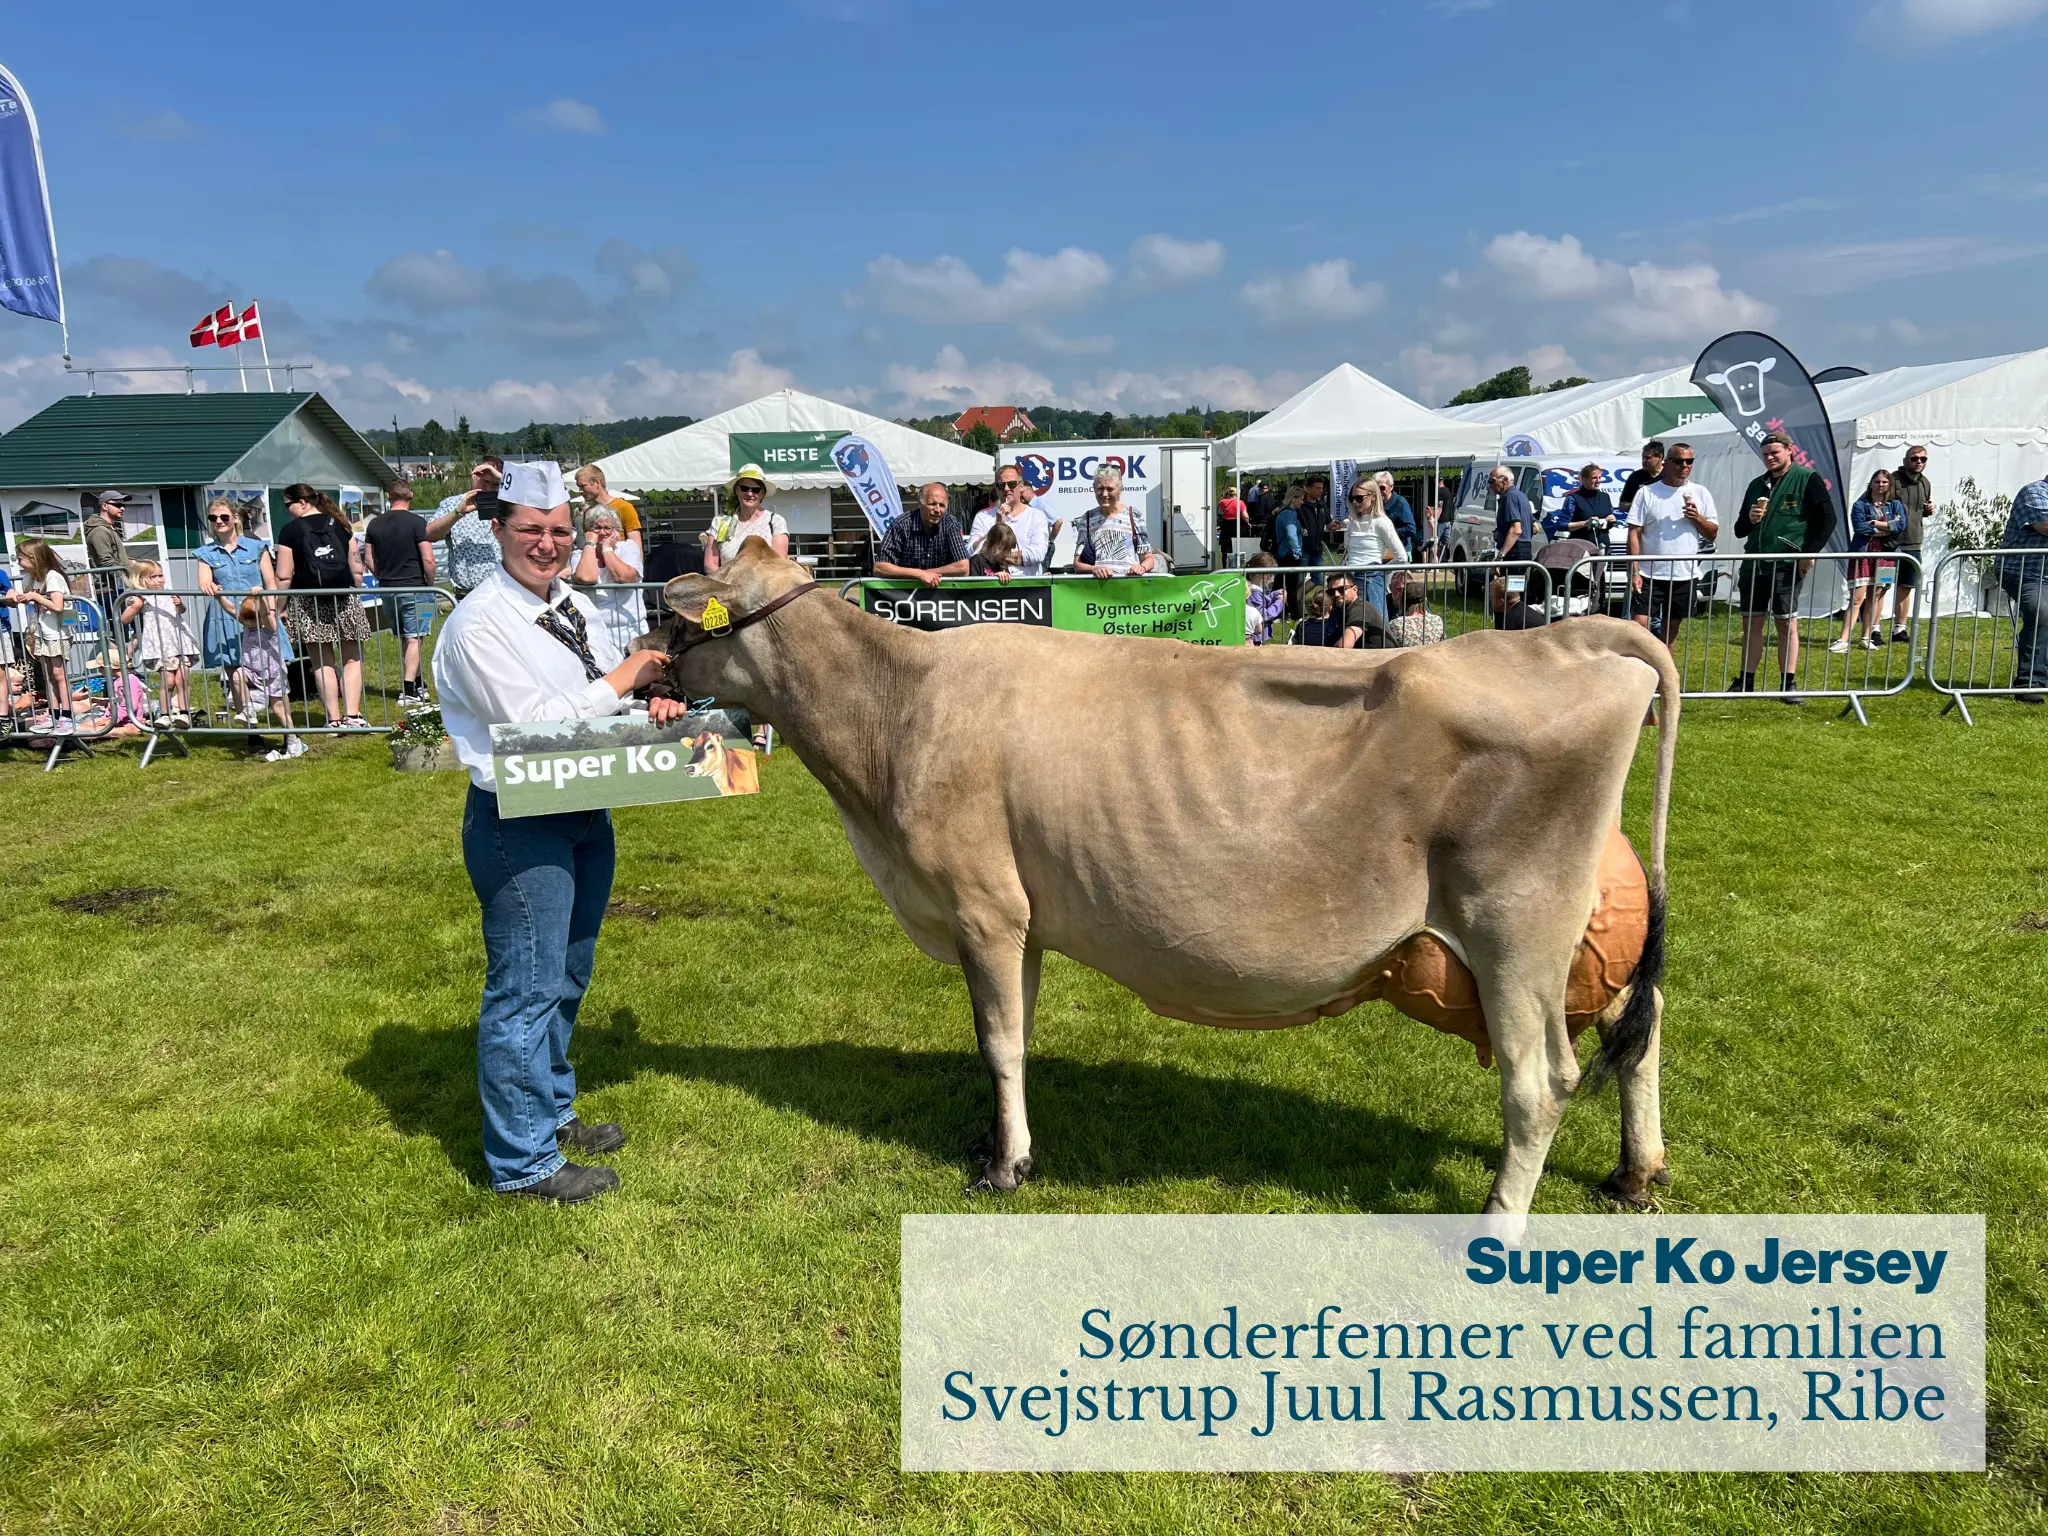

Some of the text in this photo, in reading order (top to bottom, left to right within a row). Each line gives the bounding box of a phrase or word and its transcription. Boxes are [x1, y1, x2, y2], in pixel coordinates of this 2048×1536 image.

[763, 447, 819, 463] HESTE
[1121, 484, 1148, 492] nmark
[1086, 598, 1210, 619] Bygmestervej 2
[705, 612, 728, 629] 02283
[1103, 619, 1193, 635] Øster Højst
[504, 745, 677, 789] Super Ko
